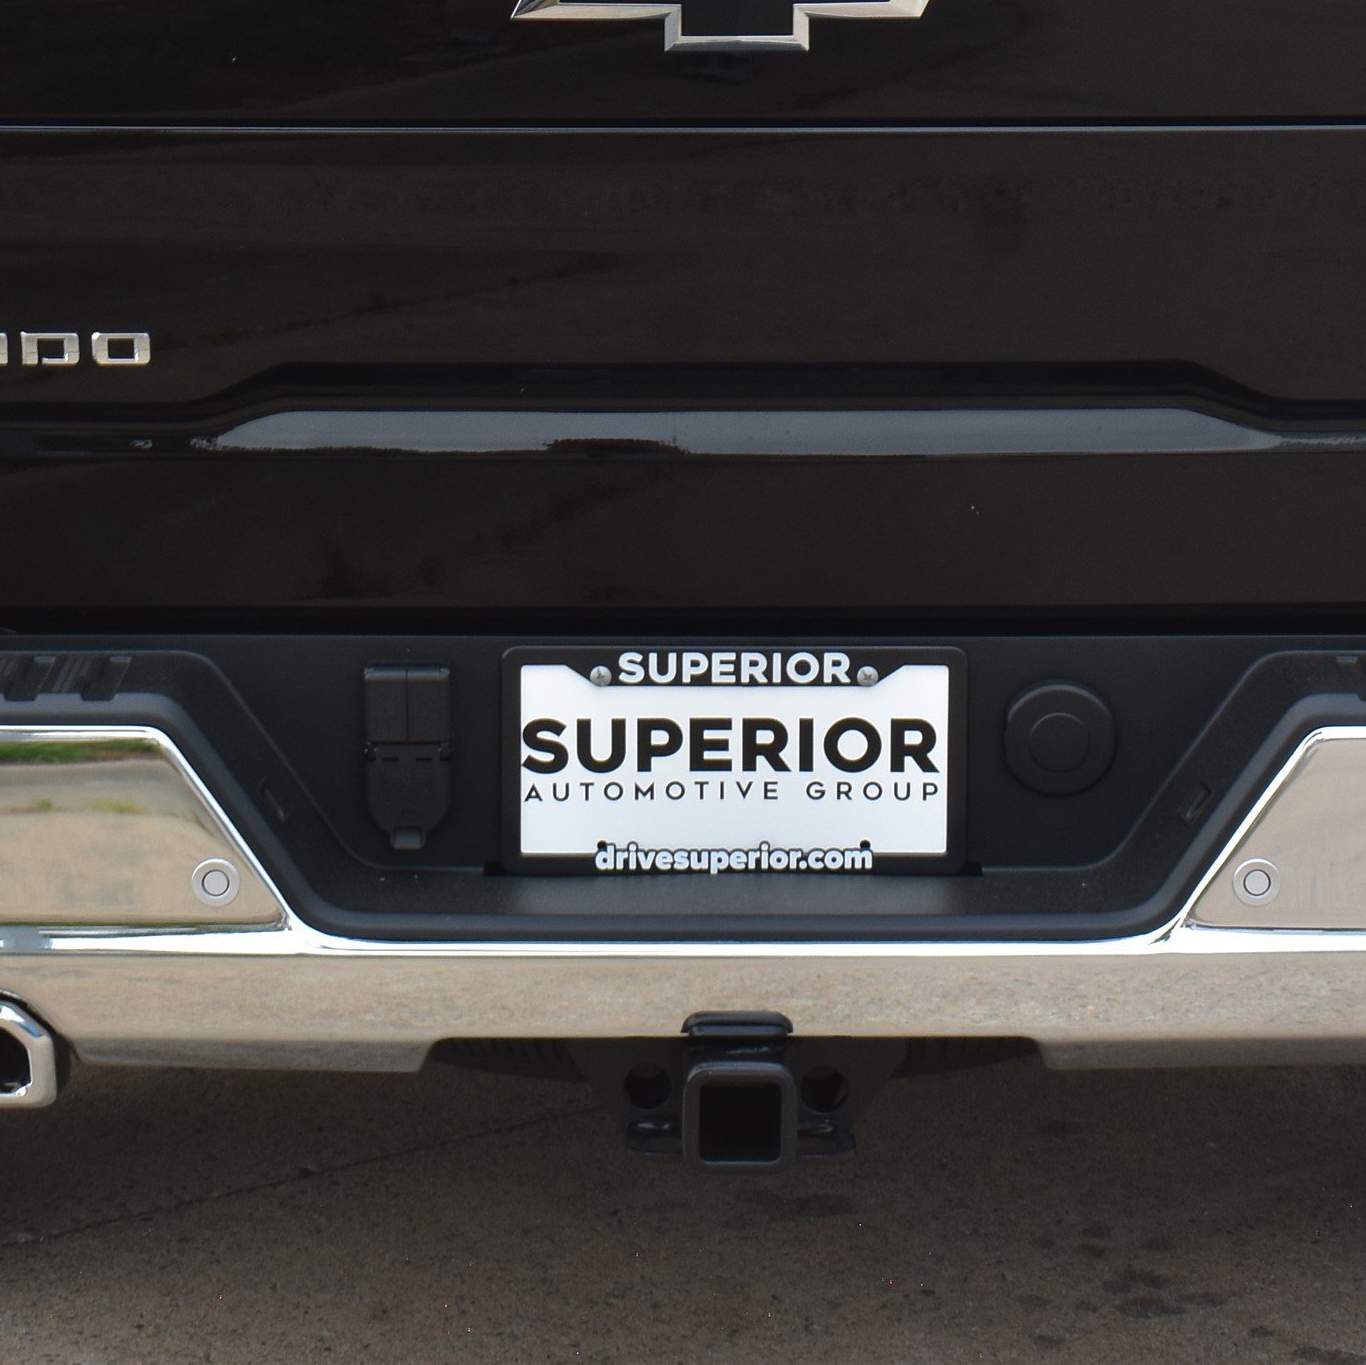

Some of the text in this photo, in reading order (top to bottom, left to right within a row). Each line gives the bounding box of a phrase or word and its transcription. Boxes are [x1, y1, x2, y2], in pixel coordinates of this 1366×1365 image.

[617, 651, 852, 685] SUPERIOR
[521, 717, 940, 775] SUPERIOR
[524, 780, 940, 802] AUTOMOTIVE GROUP
[594, 843, 874, 876] drivesuperior.com
